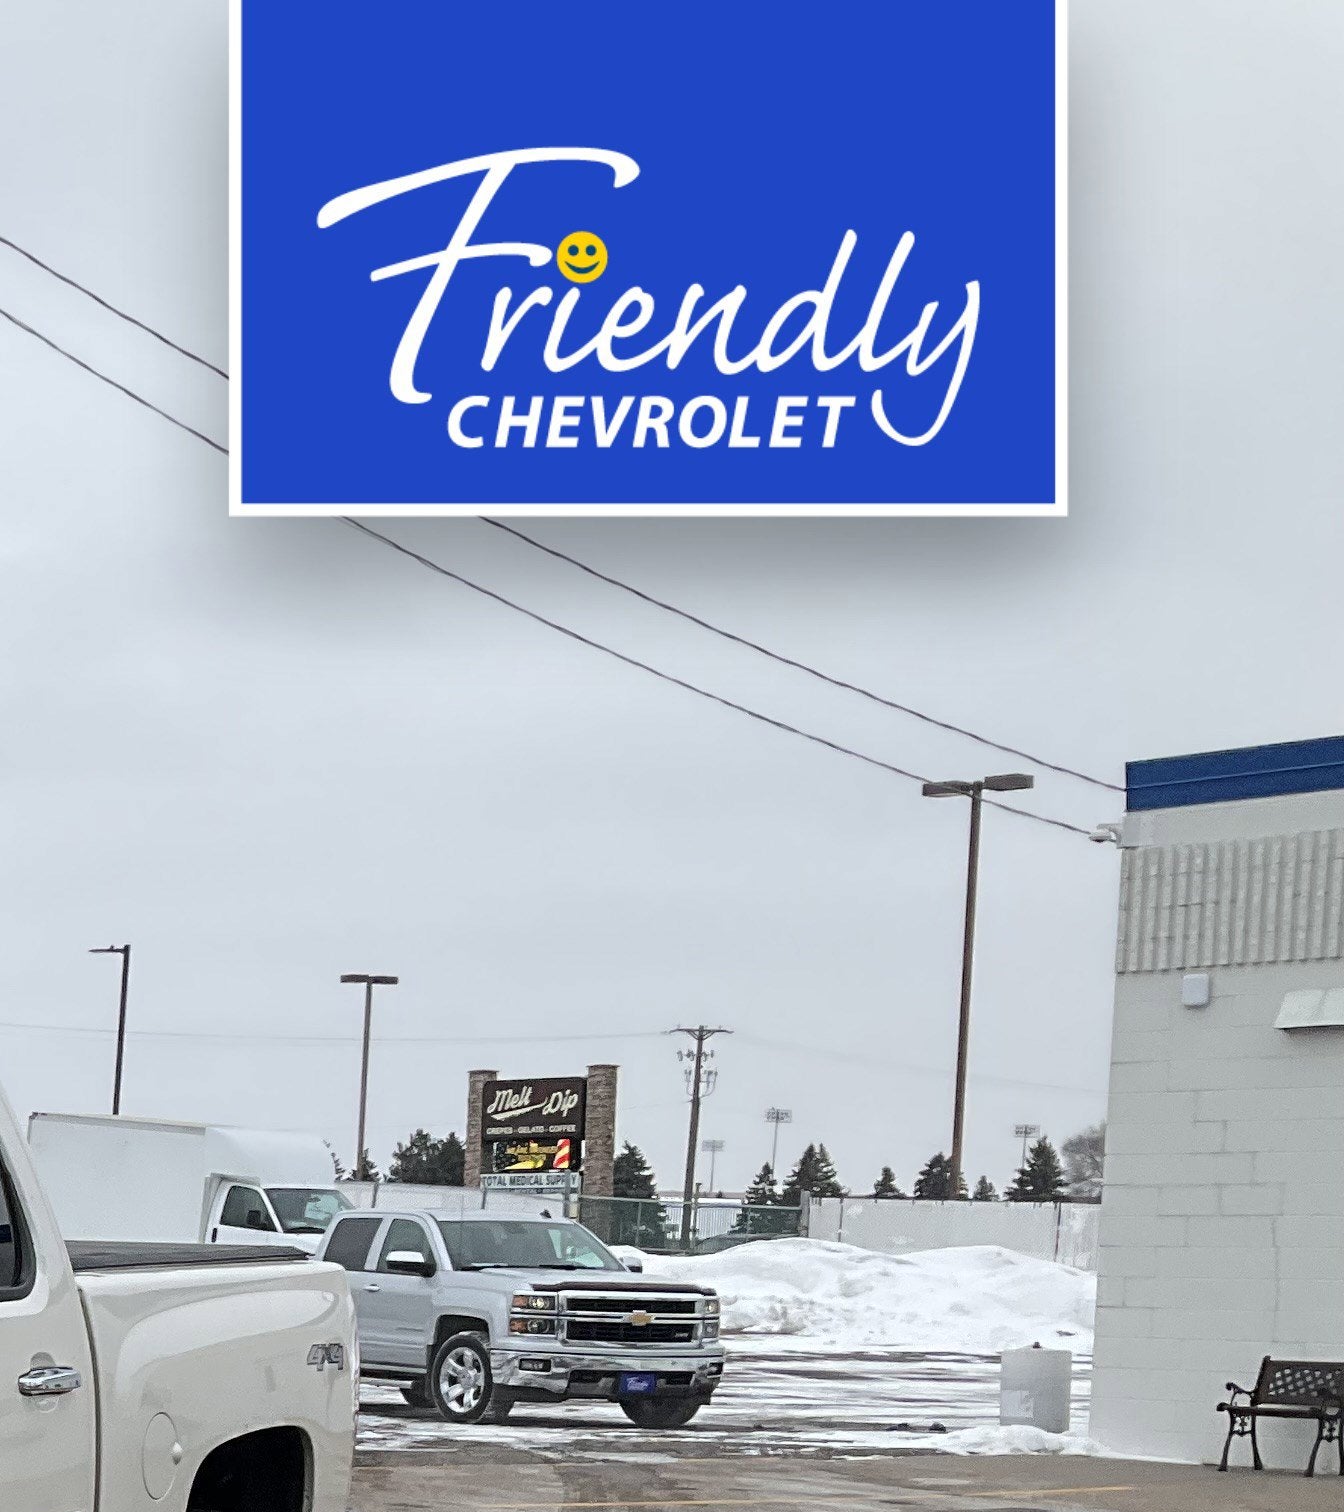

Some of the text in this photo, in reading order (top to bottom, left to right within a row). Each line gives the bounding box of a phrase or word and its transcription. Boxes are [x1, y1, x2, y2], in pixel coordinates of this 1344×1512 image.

[486, 1085, 579, 1117] Melt Dip
[548, 1124, 576, 1133] COFFEE
[482, 1175, 577, 1187] TOTAL MEDICAL SUPPY
